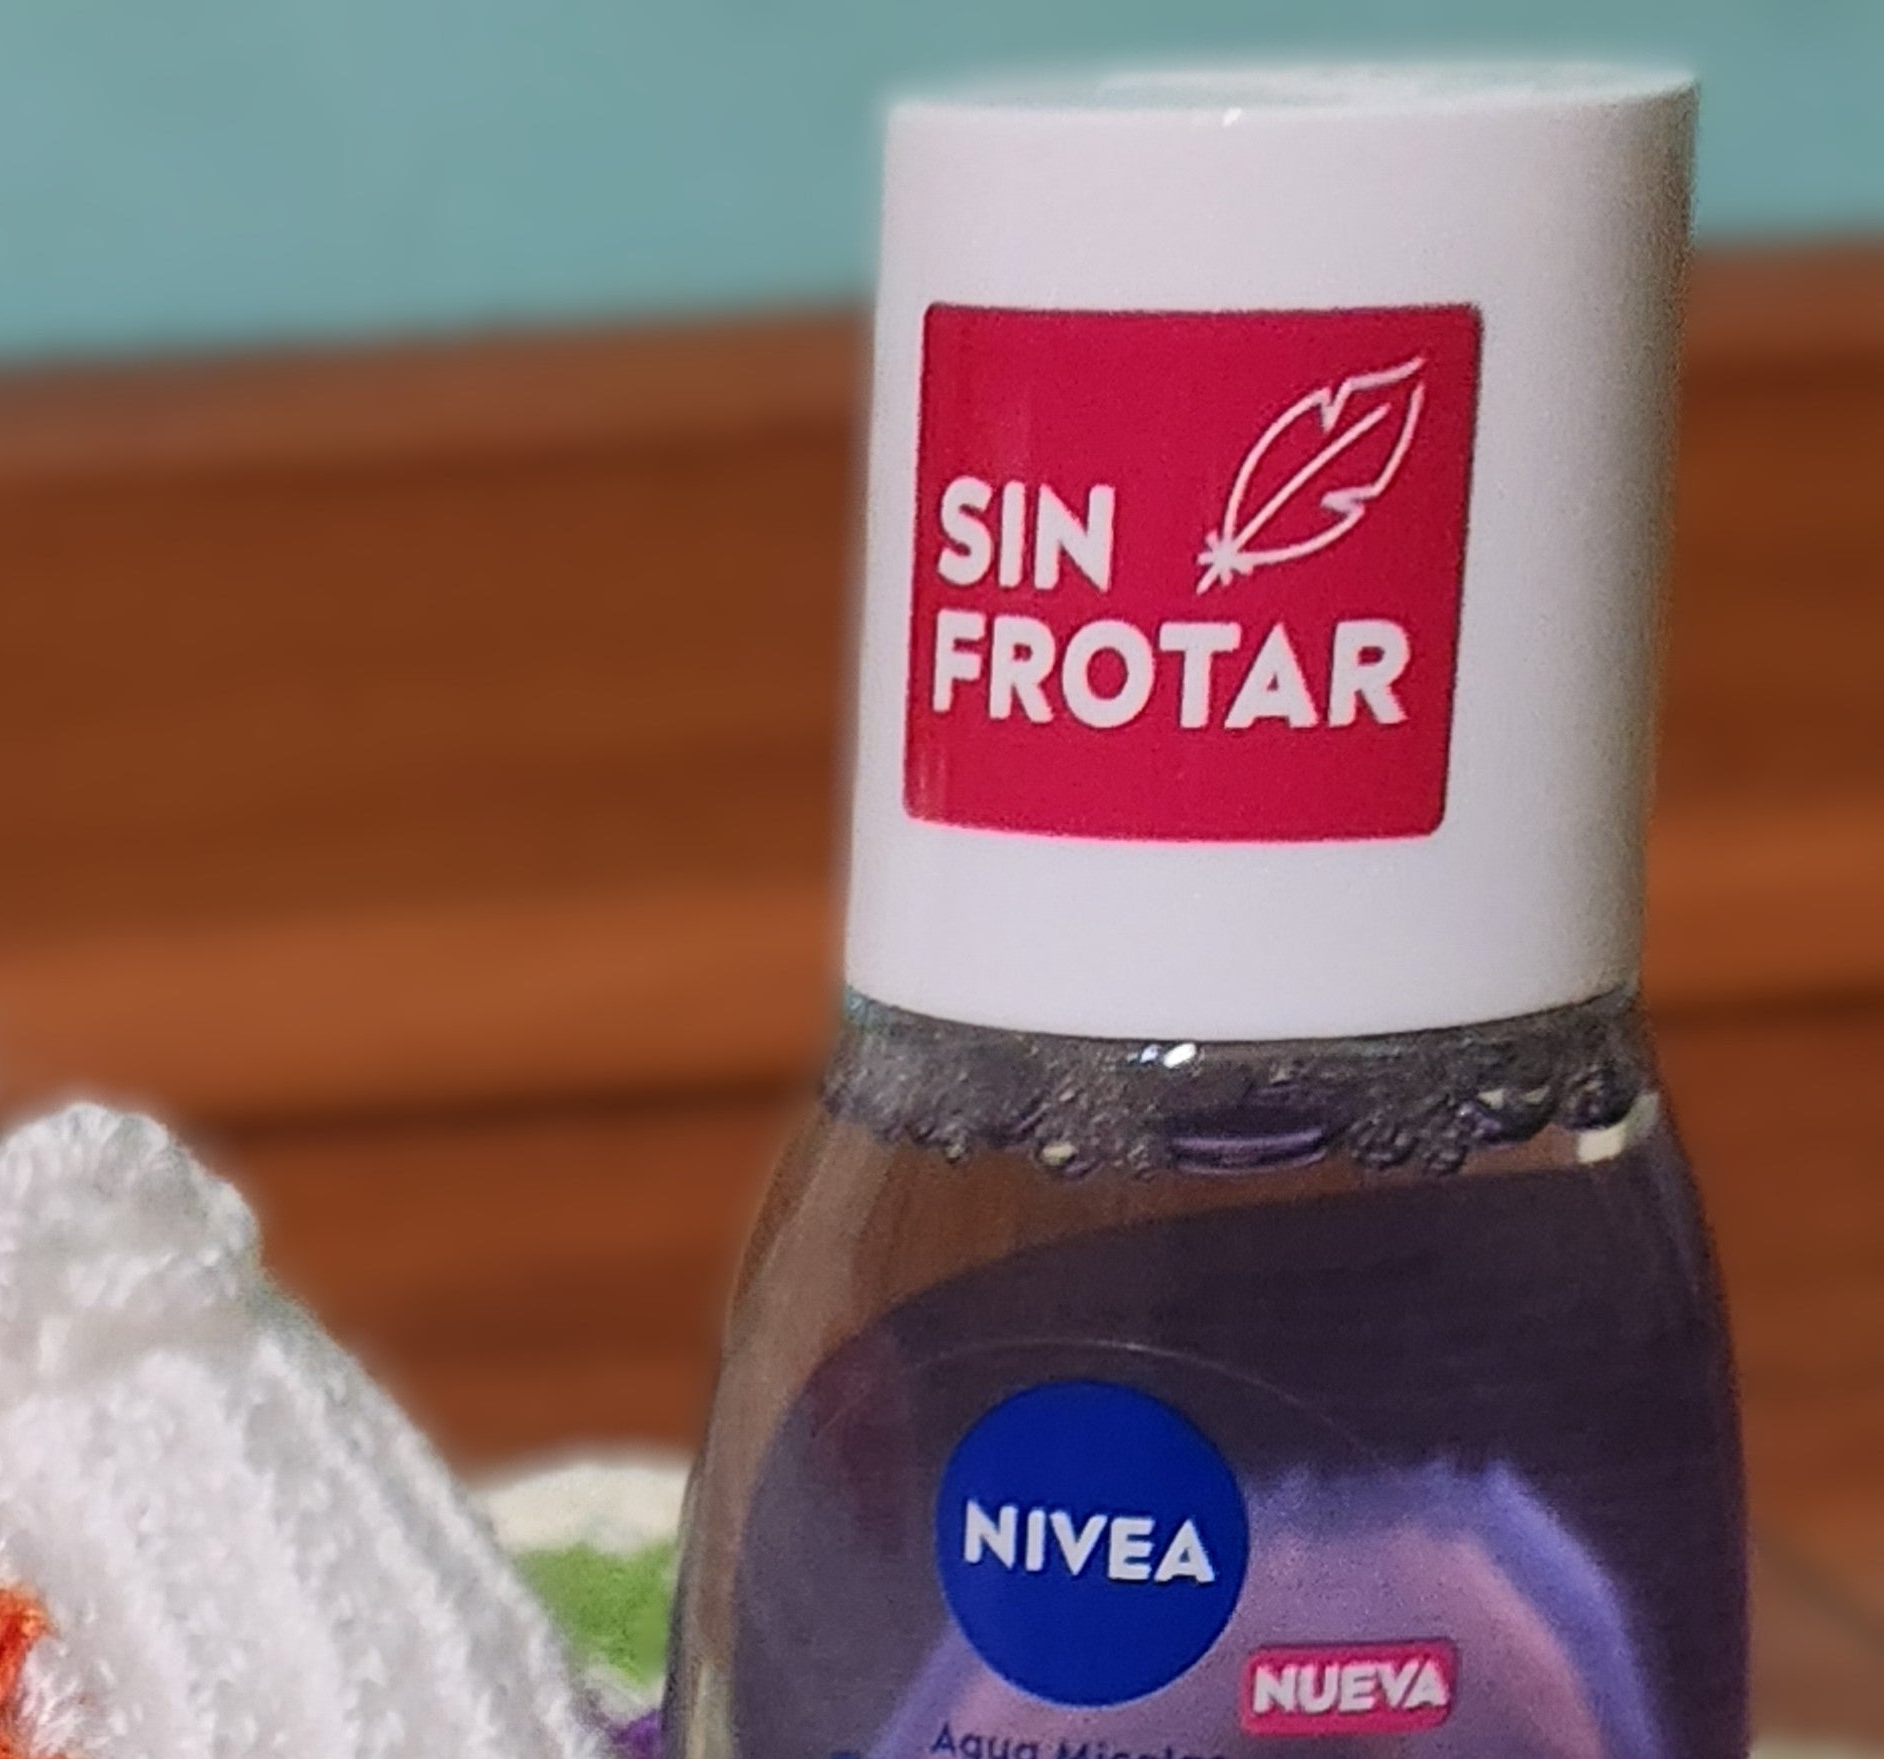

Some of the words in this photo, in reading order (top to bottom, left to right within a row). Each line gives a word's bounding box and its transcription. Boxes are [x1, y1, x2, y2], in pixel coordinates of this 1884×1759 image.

[936, 475, 1115, 593] SIN
[932, 609, 1410, 730] FROTAR
[964, 1500, 1216, 1584] NIVEA
[1252, 1656, 1450, 1716] NUEVA
